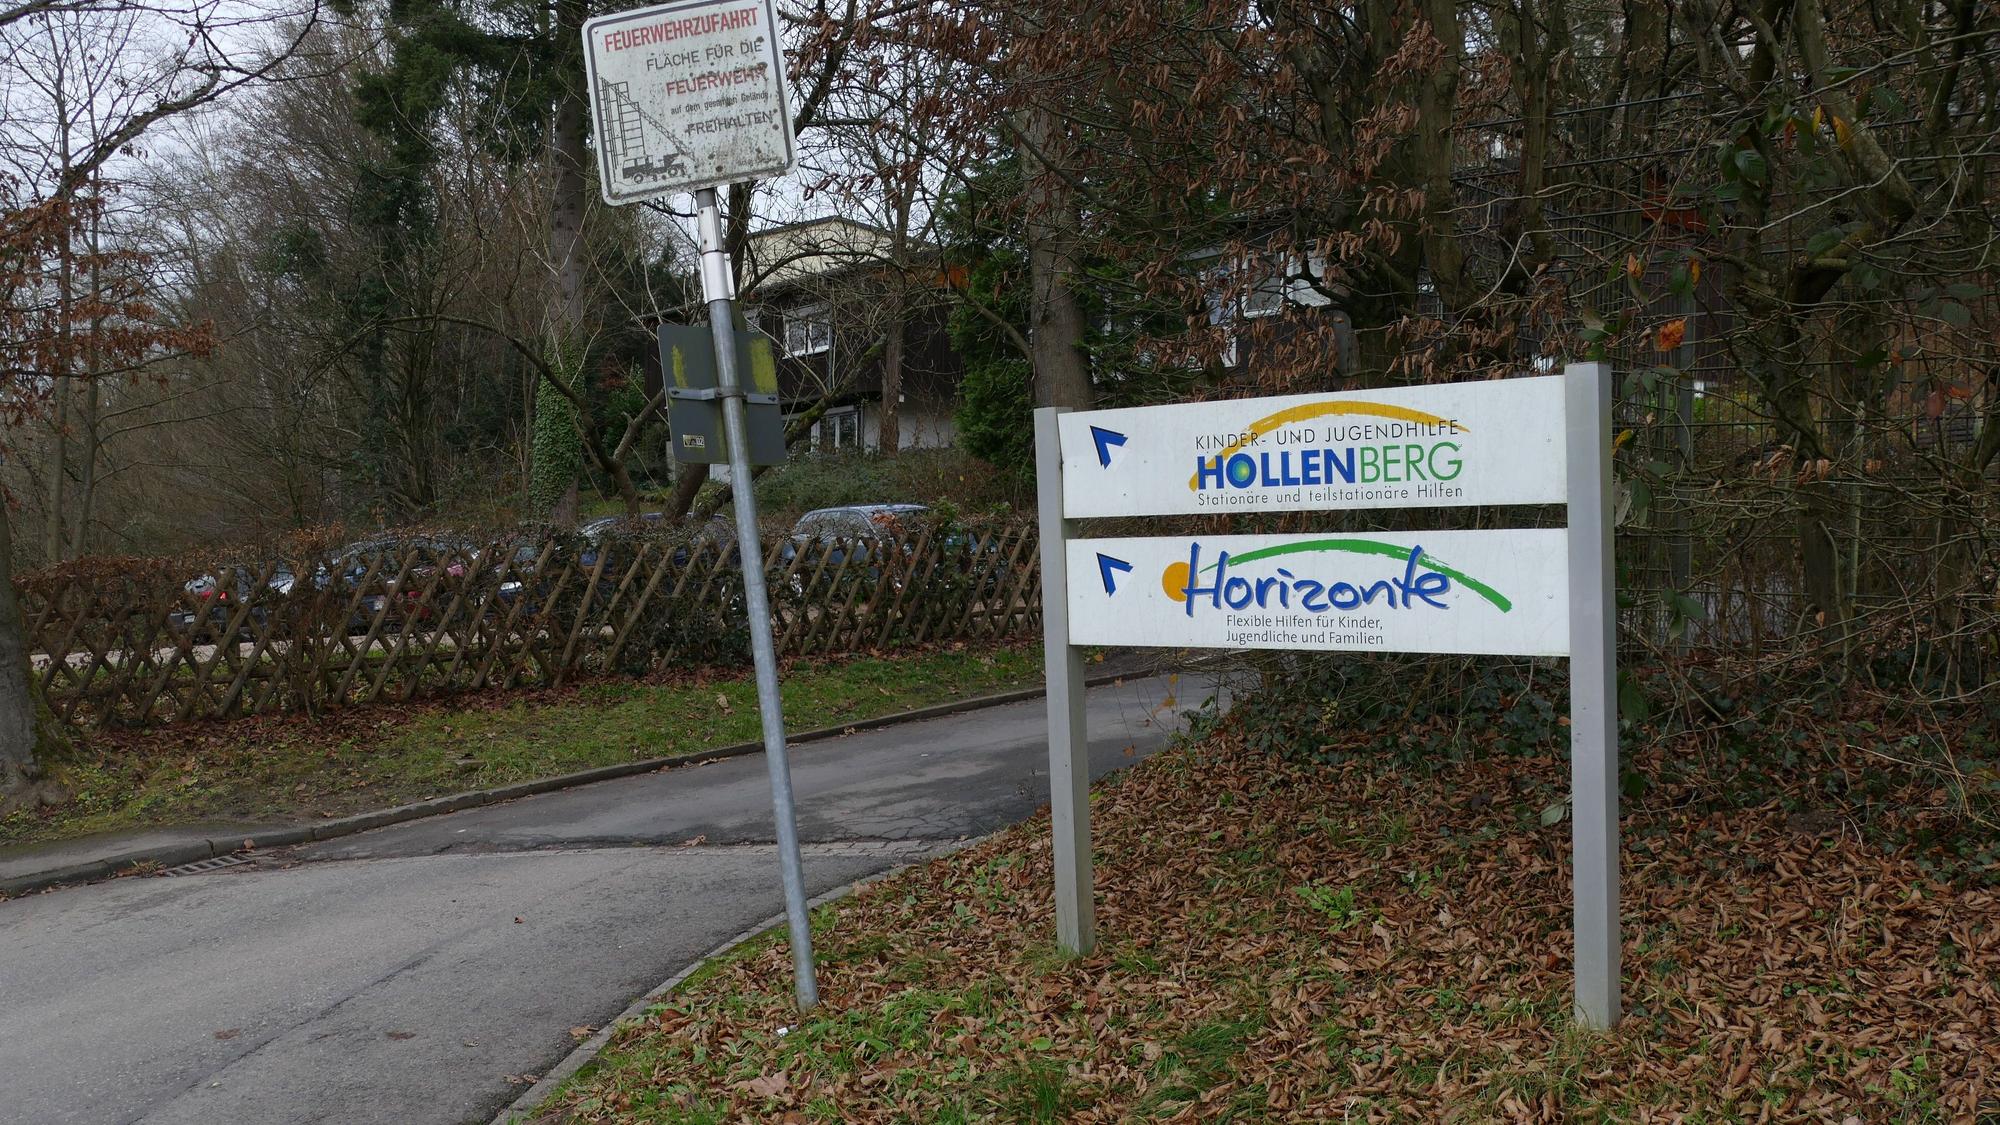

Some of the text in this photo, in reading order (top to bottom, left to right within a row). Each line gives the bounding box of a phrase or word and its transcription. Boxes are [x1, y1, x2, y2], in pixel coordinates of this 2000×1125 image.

[604, 7, 758, 52] FEUERWEHRZUFAHRT
[646, 40, 763, 71] FLÄCHE FÜR DIE
[666, 65, 768, 96] FEUERWEHR
[671, 104, 682, 115] auf
[685, 103, 701, 112] dem
[686, 110, 773, 136] FREIHALTEN
[1195, 420, 1458, 450] KINDER- UND JUGENDHILFE
[1197, 441, 1463, 490] HOLLENBERG
[1198, 482, 1463, 506] Stationäre und teilstationäre Hilfen
[1181, 541, 1450, 617] Horizonte
[1226, 614, 1383, 630] Flexible Hilfen für Kinder,
[1226, 630, 1384, 645] Jugendliche und Familien
